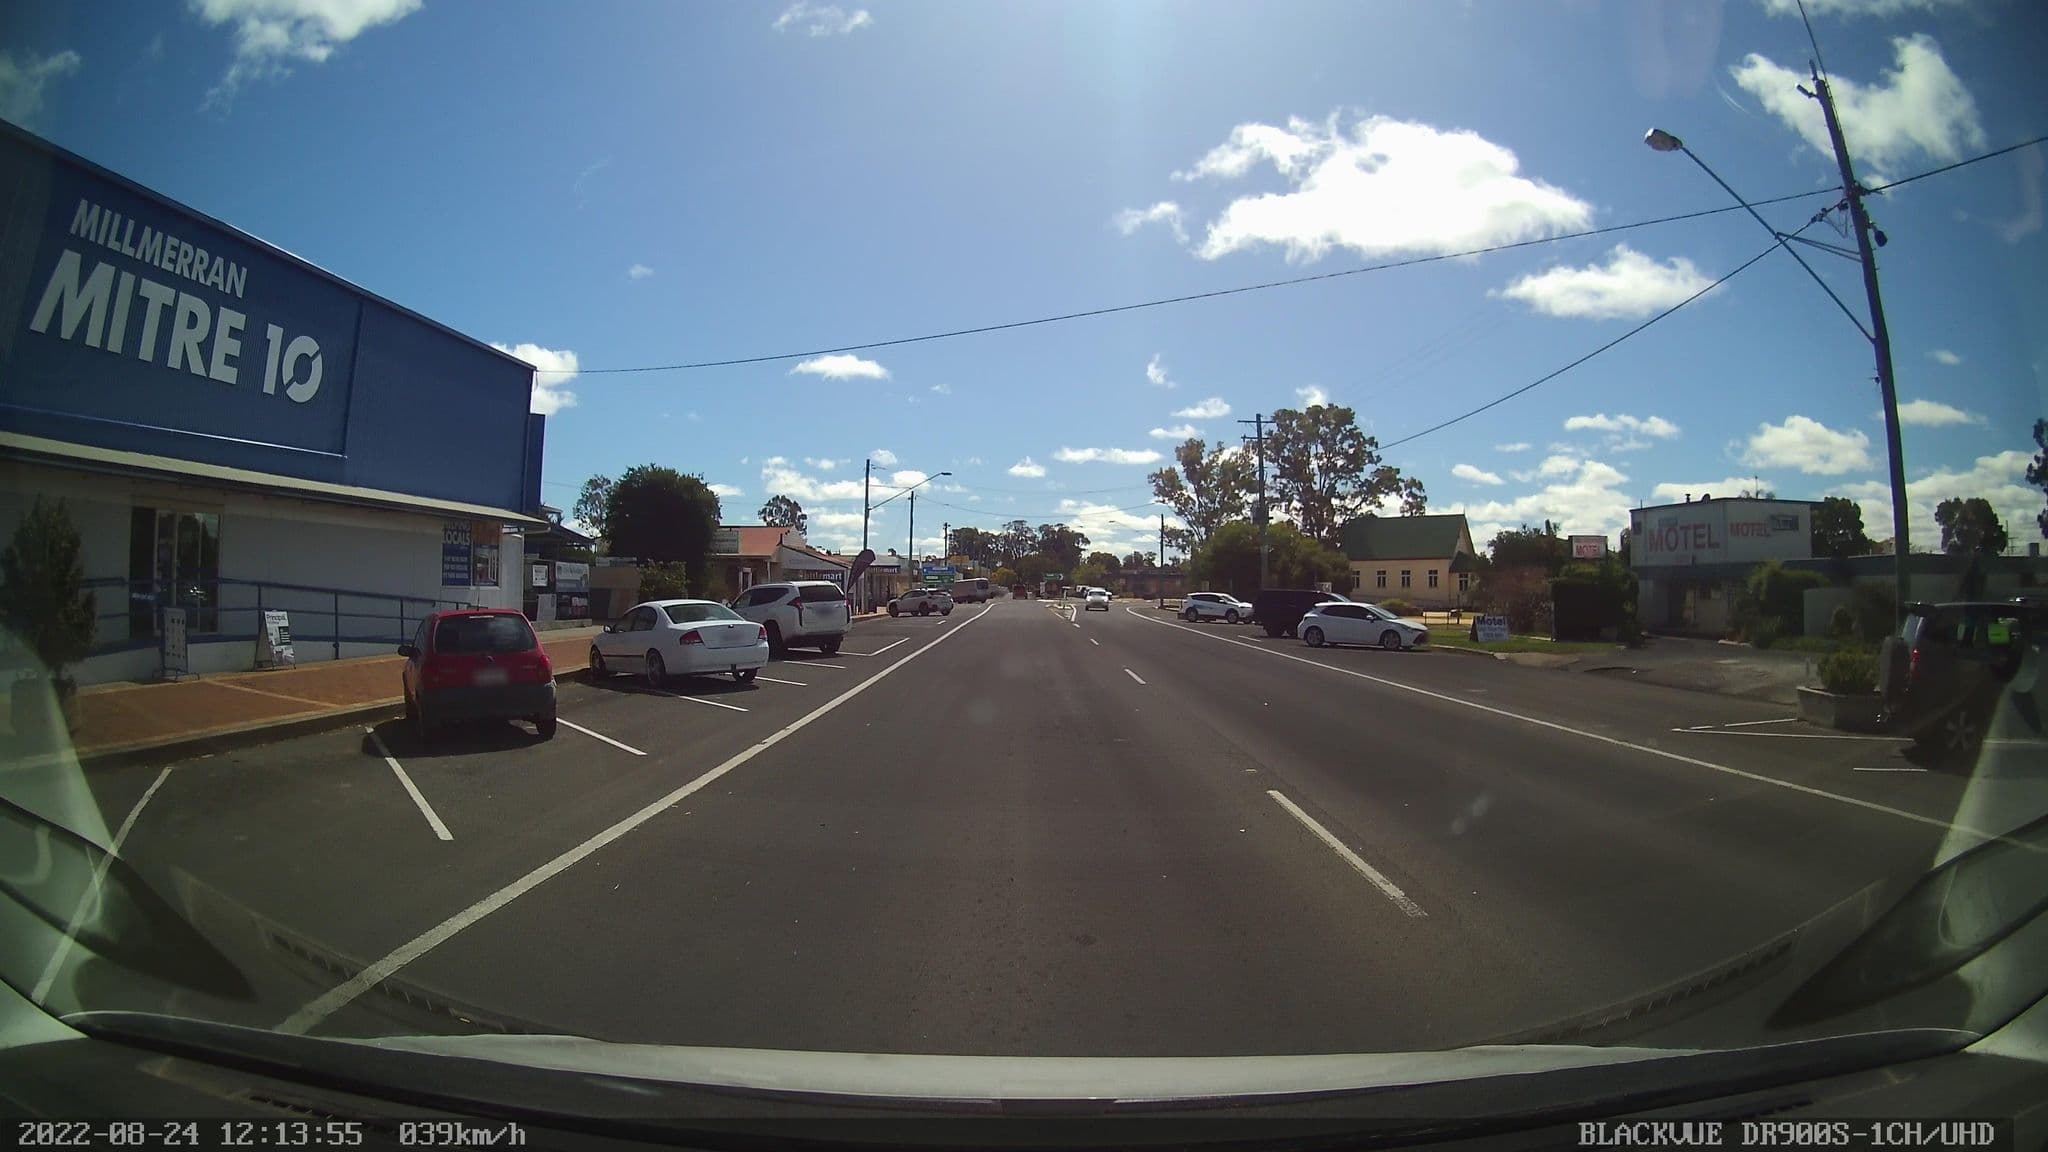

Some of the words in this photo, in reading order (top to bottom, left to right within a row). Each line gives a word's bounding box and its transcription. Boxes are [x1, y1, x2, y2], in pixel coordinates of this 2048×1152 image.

[70, 199, 248, 299] MILLMERRAN
[29, 249, 247, 385] MITRE
[262, 323, 323, 403] 10
[442, 529, 471, 546] LOCALS
[1648, 522, 1720, 553] MOTEL
[1730, 521, 1771, 537] MOTEL
[1477, 615, 1506, 626] Motel
